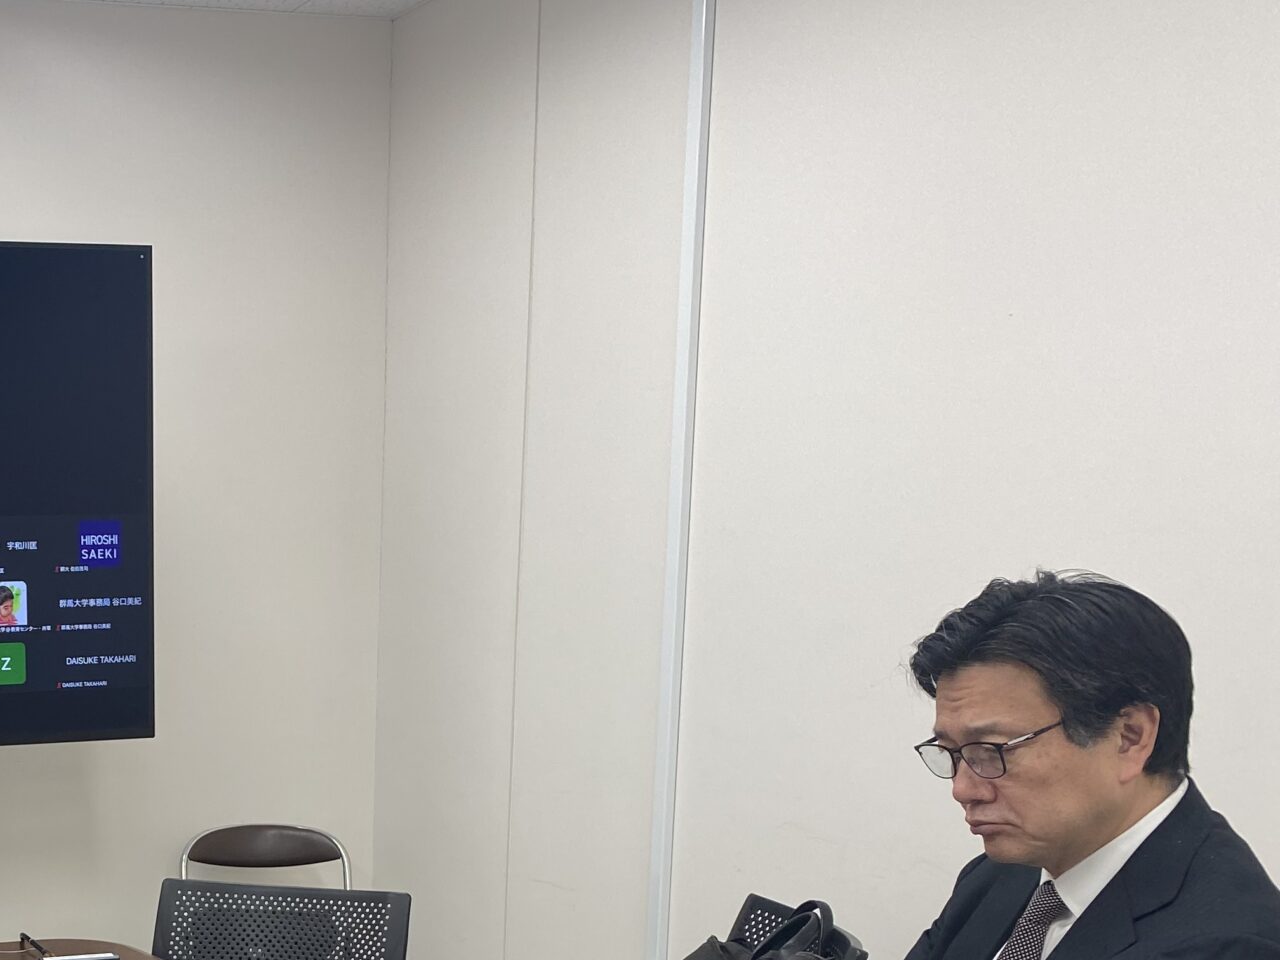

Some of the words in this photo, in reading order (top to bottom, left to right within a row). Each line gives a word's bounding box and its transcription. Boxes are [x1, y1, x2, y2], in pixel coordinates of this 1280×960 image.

[80, 534, 118, 546] HIROSHI
[81, 549, 117, 559] SAEKI
[66, 656, 99, 665] DAISUKE
[99, 655, 137, 664] TAKAHARI
